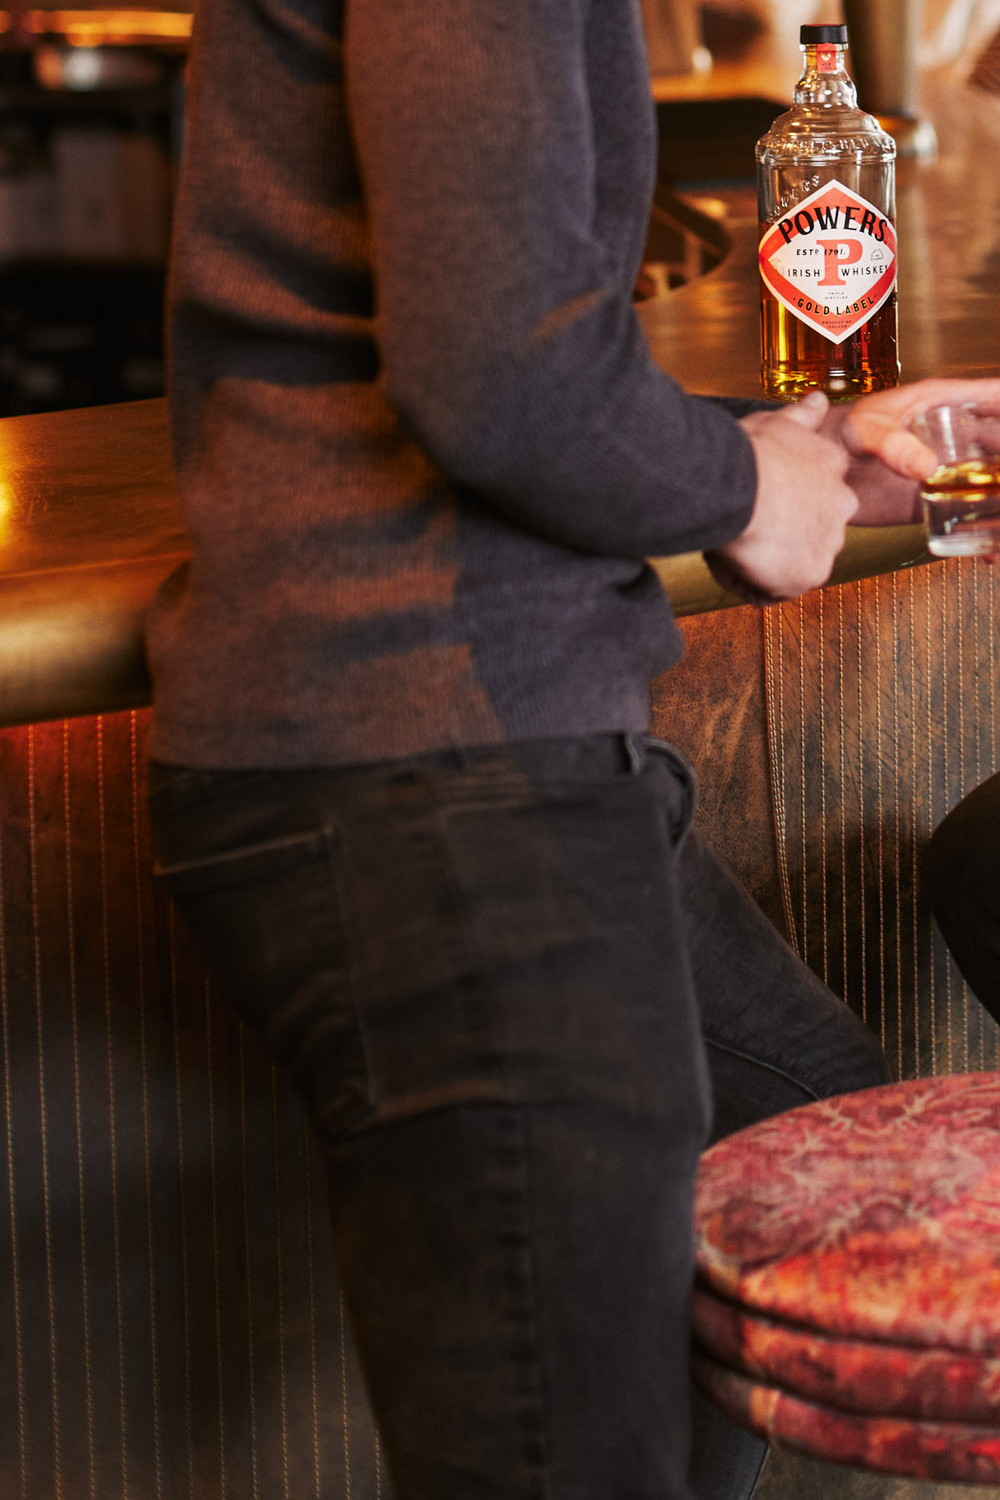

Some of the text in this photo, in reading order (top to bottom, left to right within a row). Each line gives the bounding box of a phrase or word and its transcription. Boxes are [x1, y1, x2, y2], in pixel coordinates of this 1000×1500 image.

[788, 265, 888, 278] IRISH WHISKEY
[816, 238, 863, 286] P
[797, 298, 830, 315] GOLD
[836, 296, 874, 316] LABEL
